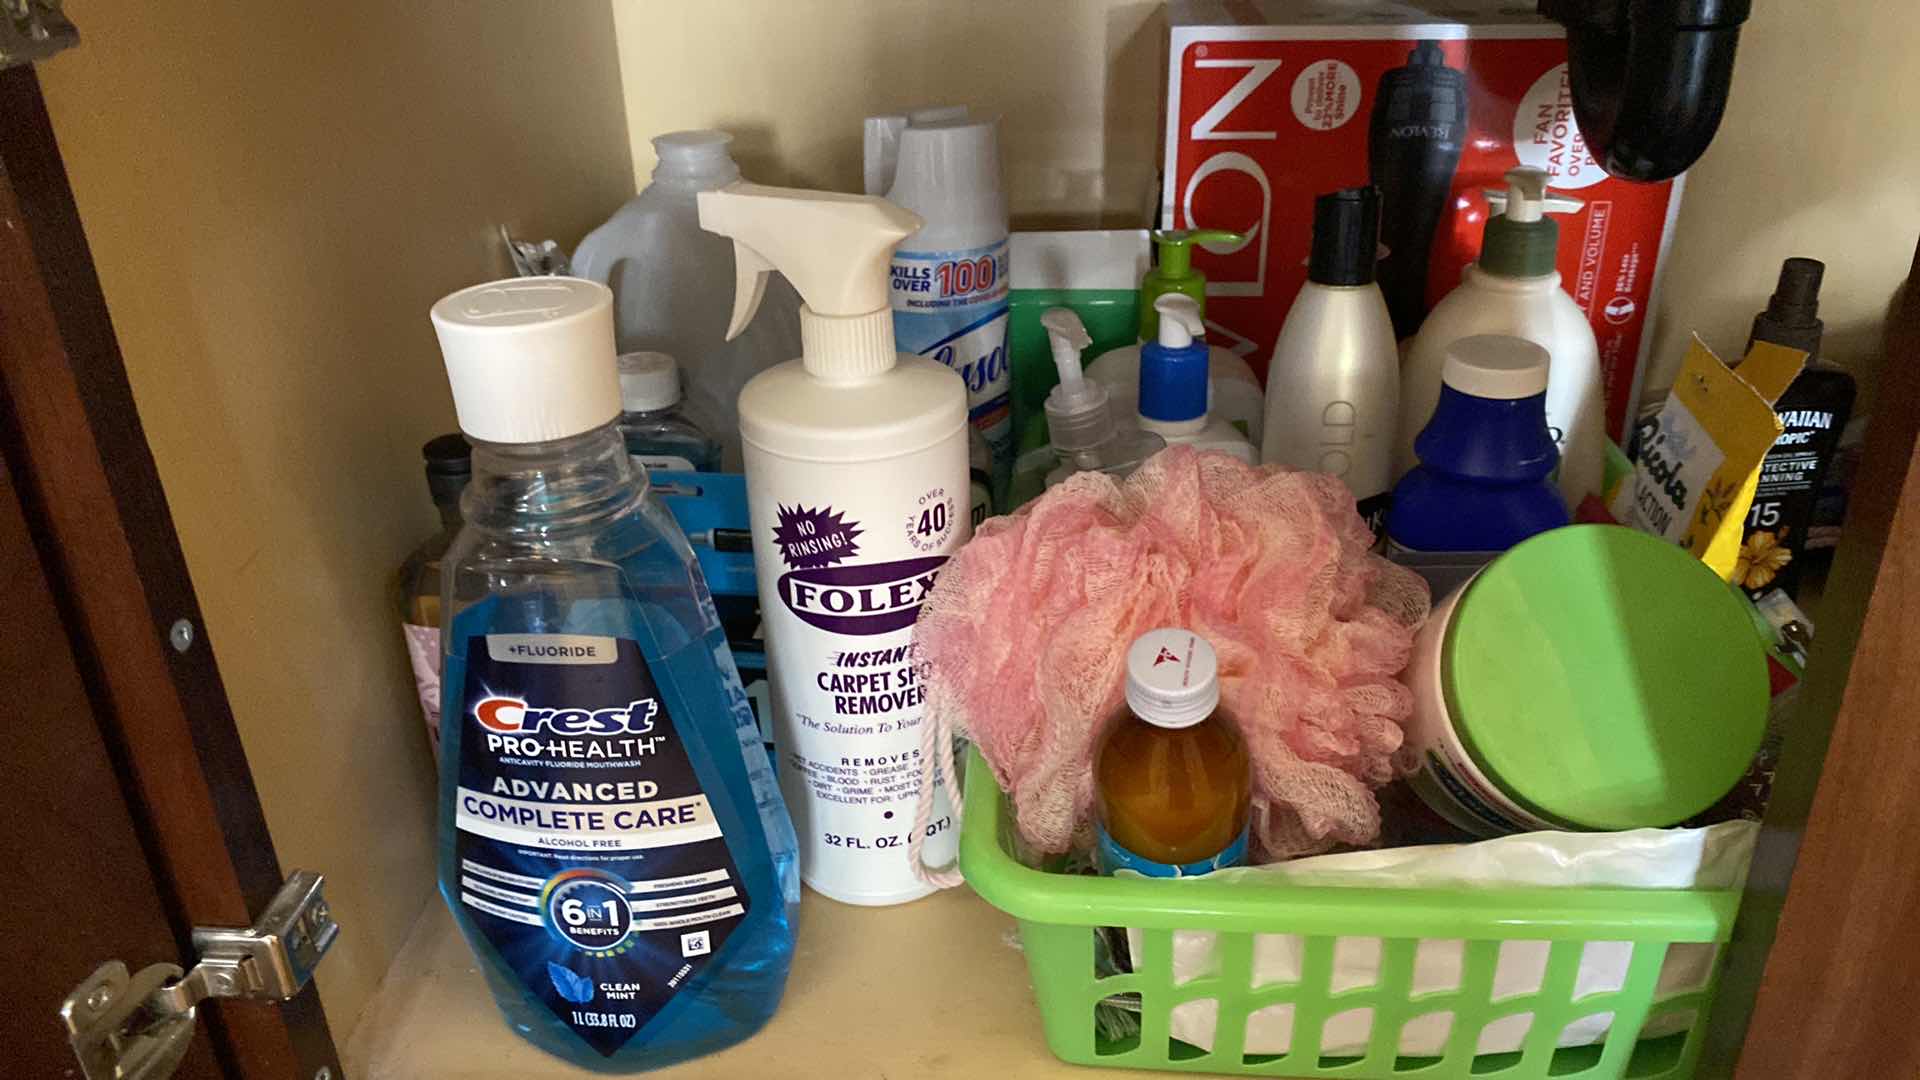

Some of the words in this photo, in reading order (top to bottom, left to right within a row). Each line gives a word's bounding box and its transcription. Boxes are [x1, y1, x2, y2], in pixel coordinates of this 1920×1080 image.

[1534, 104, 1553, 145] FAN
[1584, 208, 1606, 265] VOLUME
[890, 265, 932, 279] KILLS
[935, 255, 997, 298] 100
[893, 278, 932, 293] OVER
[1577, 271, 1594, 301] AND
[1763, 460, 1818, 473] TECTIVE
[1761, 472, 1804, 482] NNING
[918, 488, 945, 505] OVER
[917, 502, 946, 536] 40
[1751, 502, 1782, 527] 15
[797, 520, 816, 537] NO
[905, 515, 921, 549] YEARS
[921, 542, 935, 552] OF
[788, 531, 849, 559] RINSING!
[795, 571, 939, 613] FOLEX
[508, 644, 597, 658] +FLUORIDE
[836, 642, 919, 668] INSTANT
[817, 671, 892, 694] CARPET
[897, 661, 933, 688] SPO
[835, 685, 927, 715] REMOVER
[474, 697, 660, 736] Crest
[823, 722, 874, 736] Solution
[878, 721, 893, 734] To
[897, 716, 923, 731] Your
[499, 756, 544, 767] ANTICAVITY
[545, 759, 585, 769] FLUORIDE
[586, 759, 642, 769] MOUTHWASH
[841, 749, 921, 767] REMOVES
[868, 763, 909, 777] GREASE
[492, 776, 659, 802] ADVANCED
[826, 775, 860, 786] BLOOD
[869, 775, 897, 786] RUST
[816, 789, 868, 805] EXCELLENT
[463, 796, 605, 831] COMPLETE
[538, 836, 590, 848] ALCOHOL
[593, 838, 622, 848] FREE
[824, 833, 842, 847] 32
[846, 836, 871, 849] FL.
[875, 834, 904, 849] OZ.
[561, 898, 587, 926] 6
[586, 906, 603, 919] IN
[602, 900, 620, 927] 1
[569, 926, 620, 936] BENEFITS
[600, 983, 641, 991] CLEAN
[606, 991, 636, 1000] MINT
[584, 1012, 608, 1027] (33.8
[607, 1013, 620, 1028] FL
